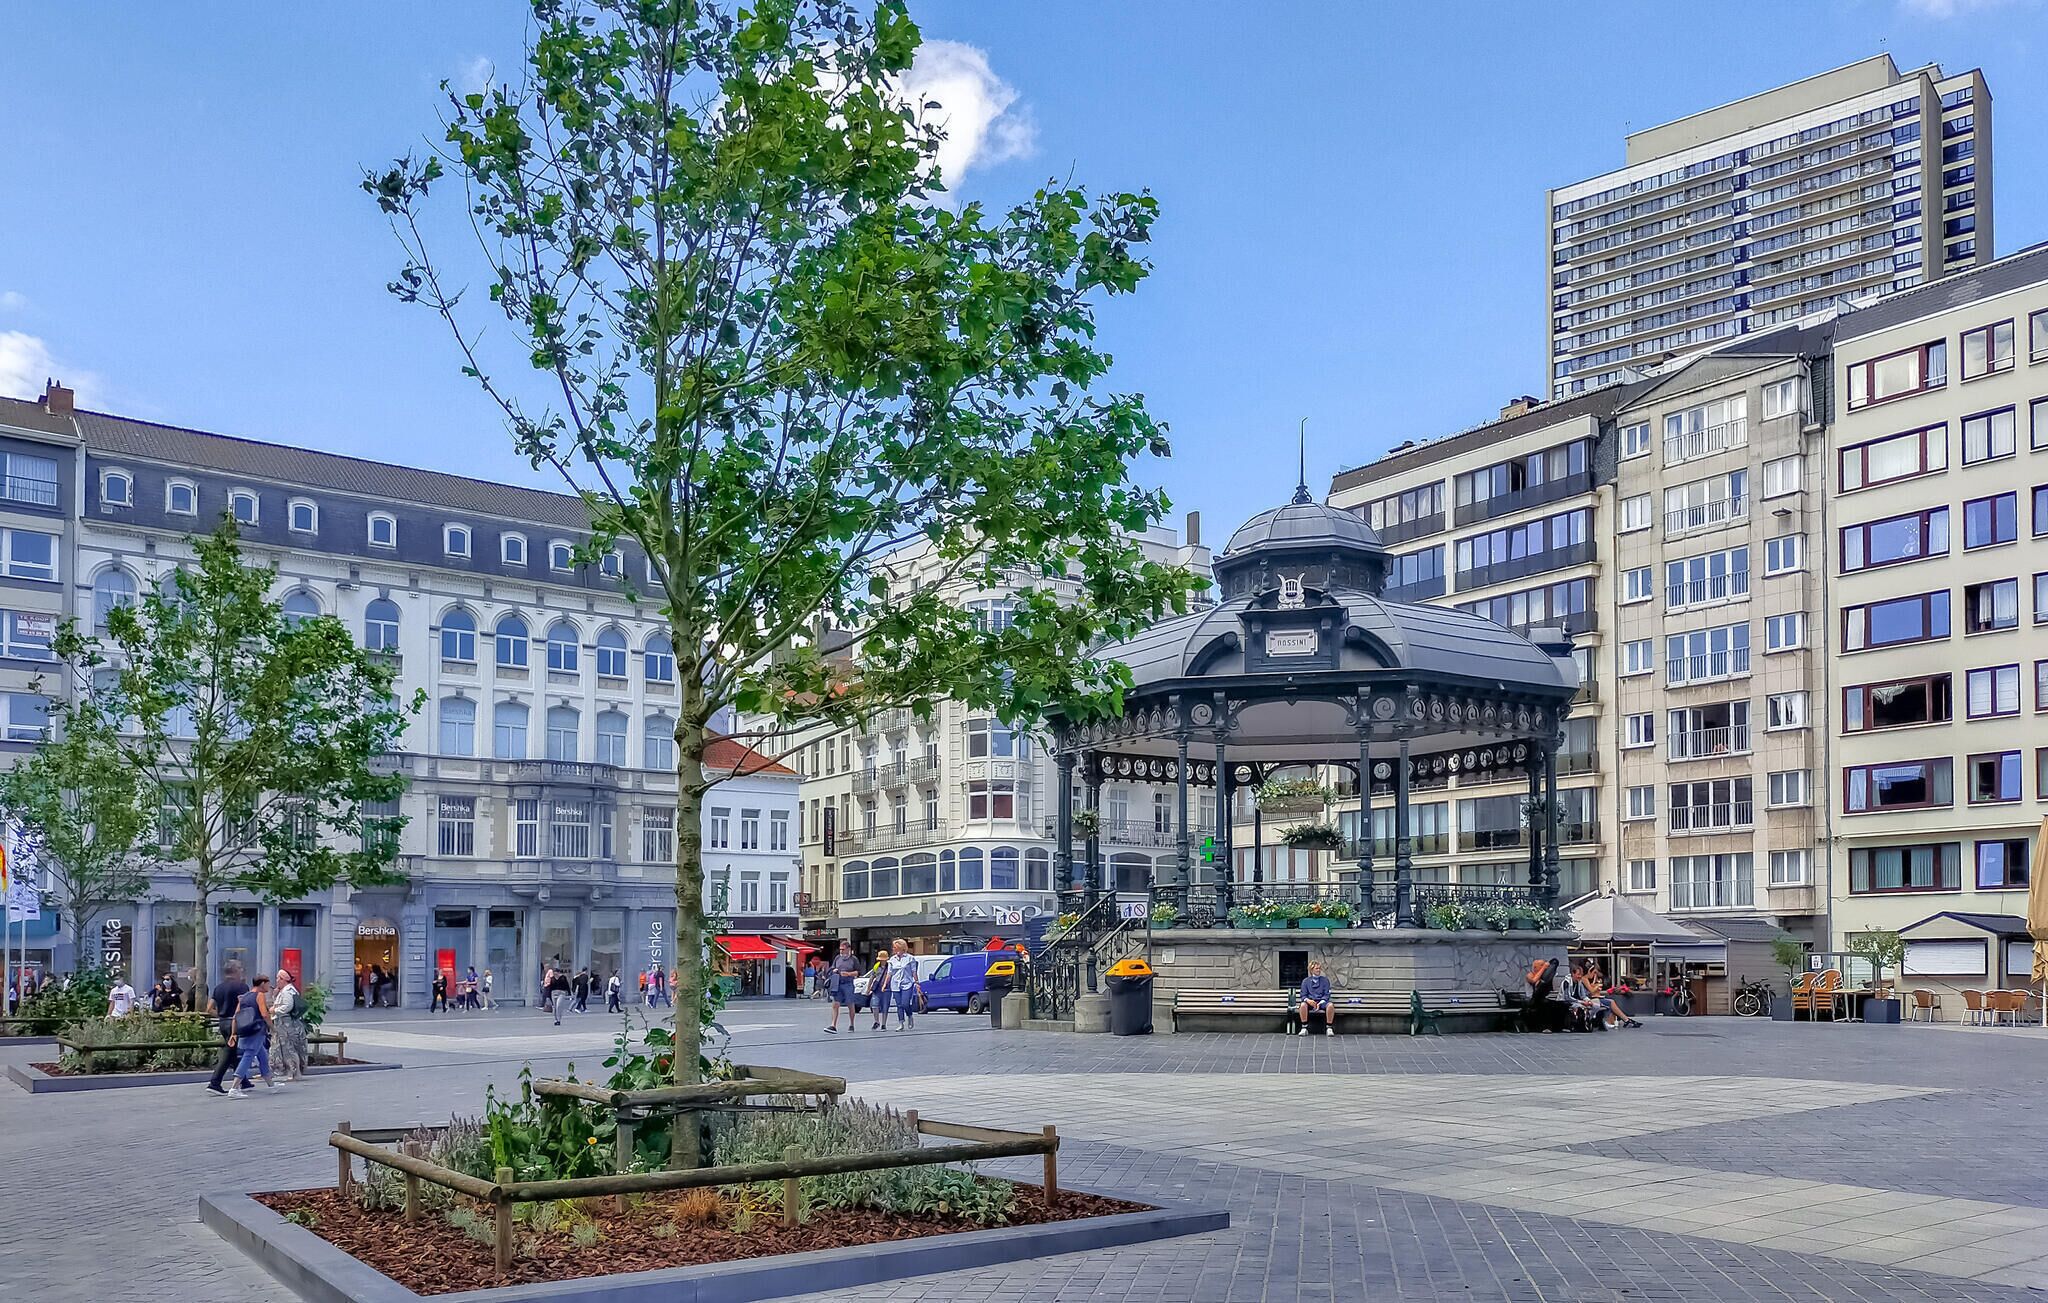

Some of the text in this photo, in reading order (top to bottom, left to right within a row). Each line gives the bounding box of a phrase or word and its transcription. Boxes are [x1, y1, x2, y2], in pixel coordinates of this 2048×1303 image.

[441, 803, 470, 812] Bershka
[555, 806, 583, 815] Bershka
[644, 813, 669, 821] Bershka
[940, 904, 1042, 919] MANO
[358, 925, 396, 935] Bershka
[648, 921, 662, 972] ershka
